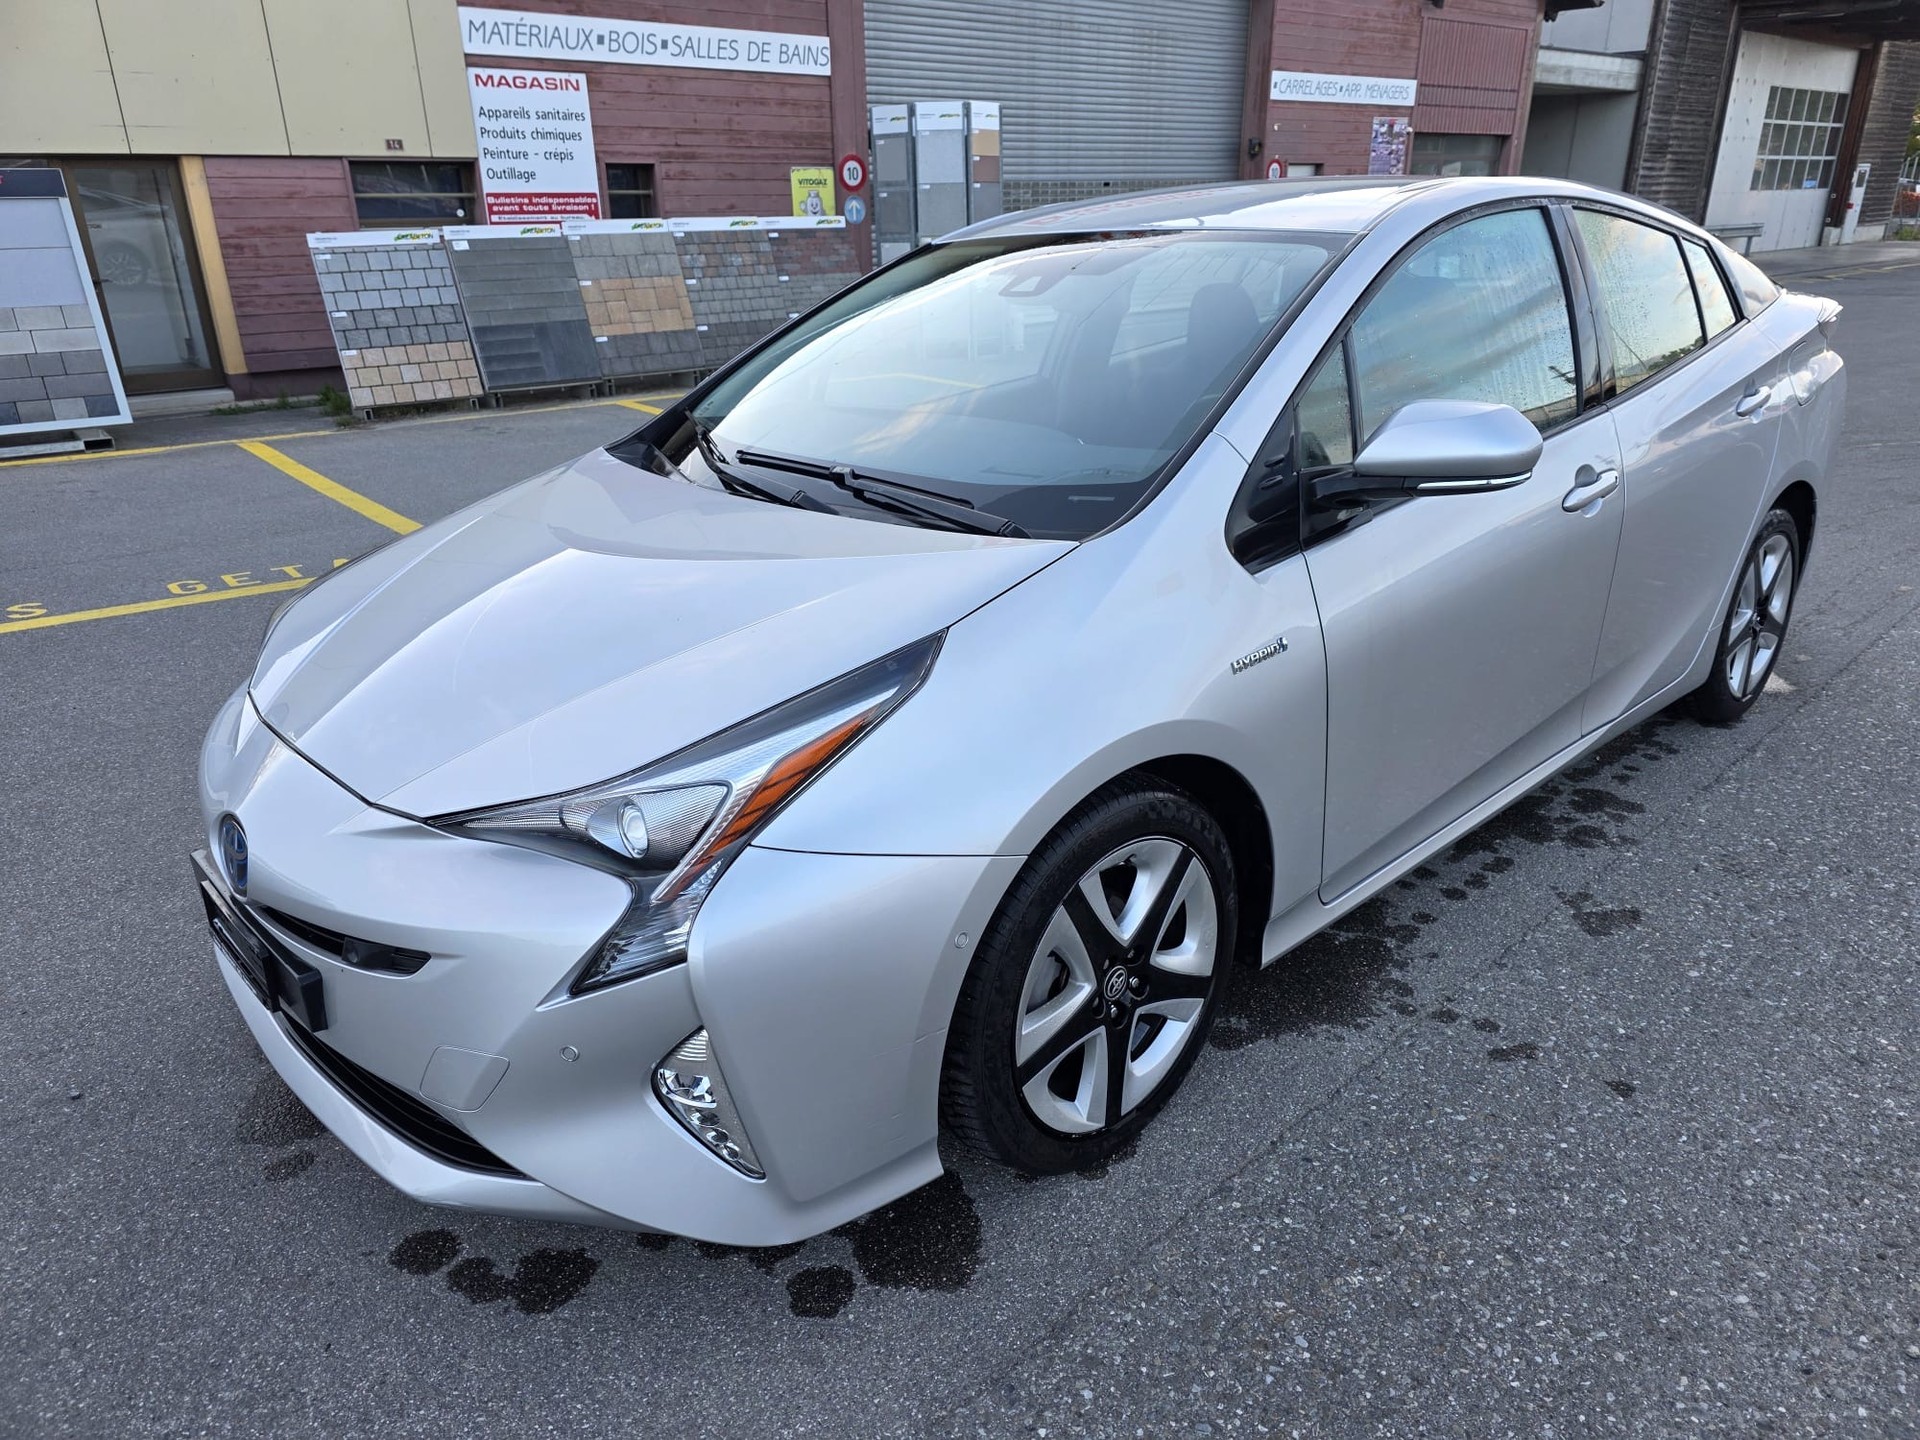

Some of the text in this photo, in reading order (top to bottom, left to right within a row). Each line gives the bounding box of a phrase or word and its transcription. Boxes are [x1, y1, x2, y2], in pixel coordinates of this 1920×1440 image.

[468, 17, 830, 67] MATÉRIAUX BOIS SALLES DE BAINS
[474, 73, 580, 92] MAGASIN
[1278, 78, 1339, 97] CARRELAGES
[478, 106, 586, 122] Appareils sanitaires
[480, 126, 583, 144] Produits chimiques
[482, 147, 529, 160] Peinture
[543, 148, 574, 164] crépis
[486, 167, 536, 183] Outillage
[797, 178, 828, 186] VITOGAZ
[847, 167, 859, 181] 10
[487, 196, 530, 204] Bulletins
